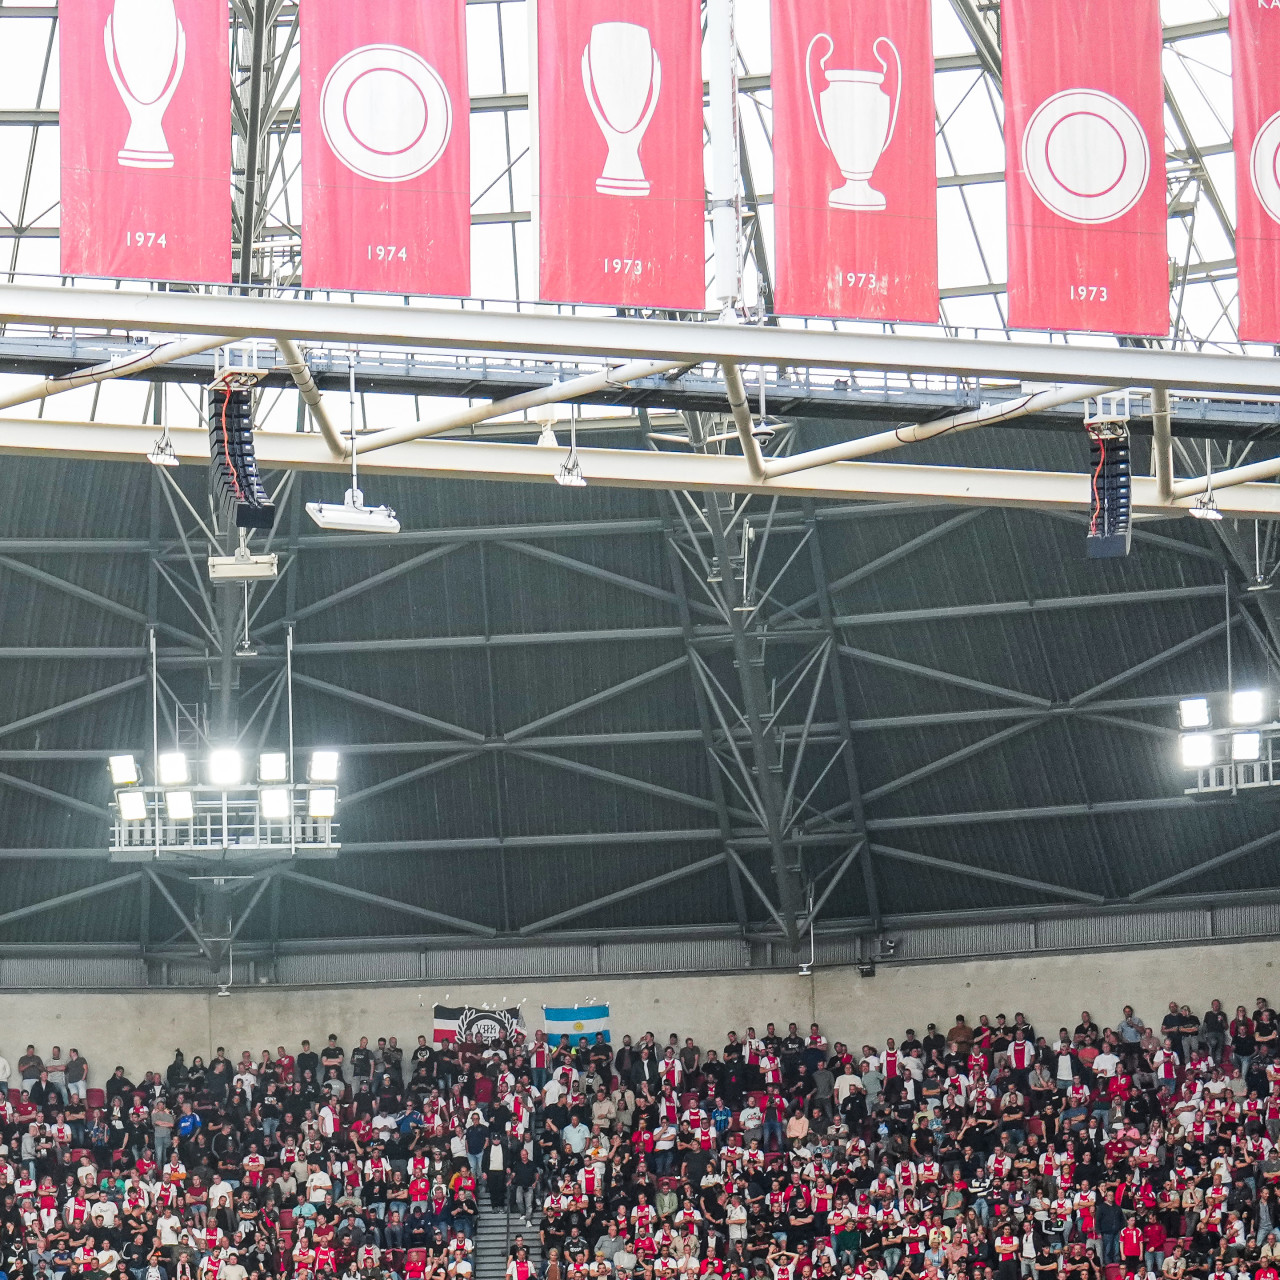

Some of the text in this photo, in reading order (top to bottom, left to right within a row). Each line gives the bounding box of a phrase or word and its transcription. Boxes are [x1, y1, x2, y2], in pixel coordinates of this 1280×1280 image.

[126, 231, 167, 248] 1974
[368, 245, 407, 261] 1974
[604, 258, 642, 274] 1973
[838, 272, 876, 288] 1973
[1070, 285, 1108, 302] 1973
